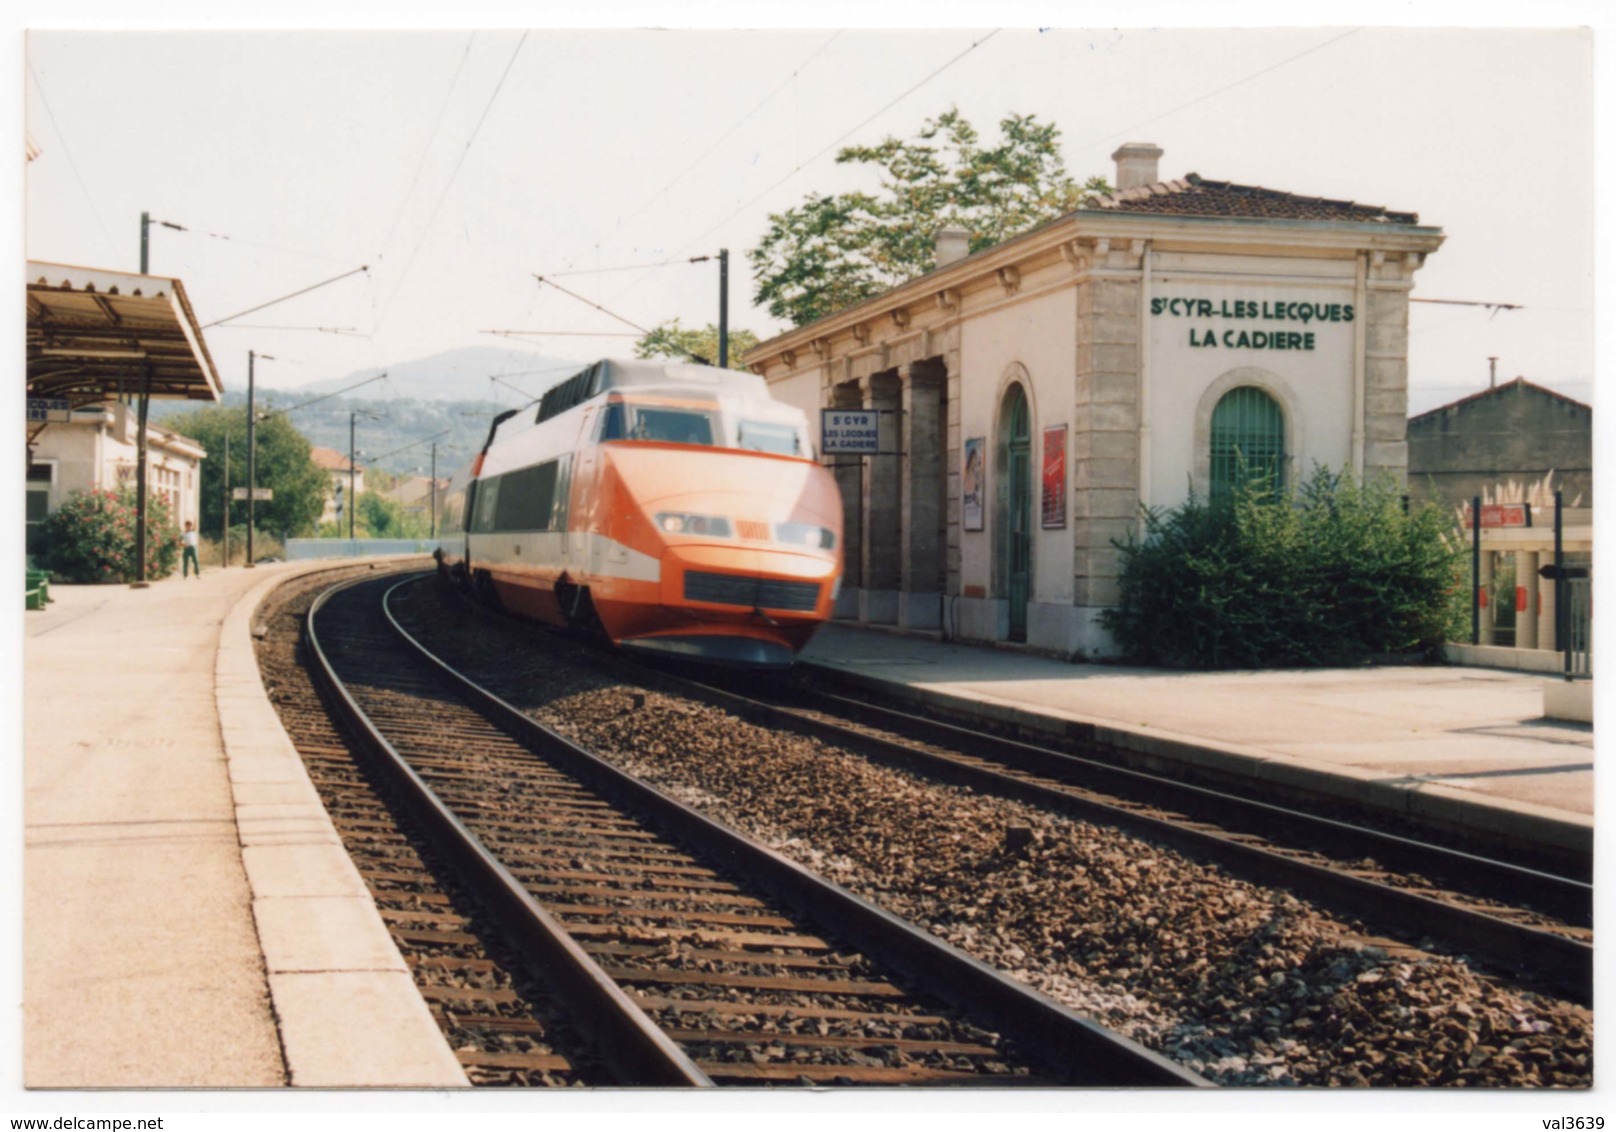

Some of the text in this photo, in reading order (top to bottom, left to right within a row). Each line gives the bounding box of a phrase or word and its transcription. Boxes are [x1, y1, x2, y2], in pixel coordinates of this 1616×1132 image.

[1262, 301, 1354, 323] LECQUES
[1189, 328, 1315, 350] LA CADIERE
[844, 415, 868, 425] CYR
[824, 440, 837, 448] LA
